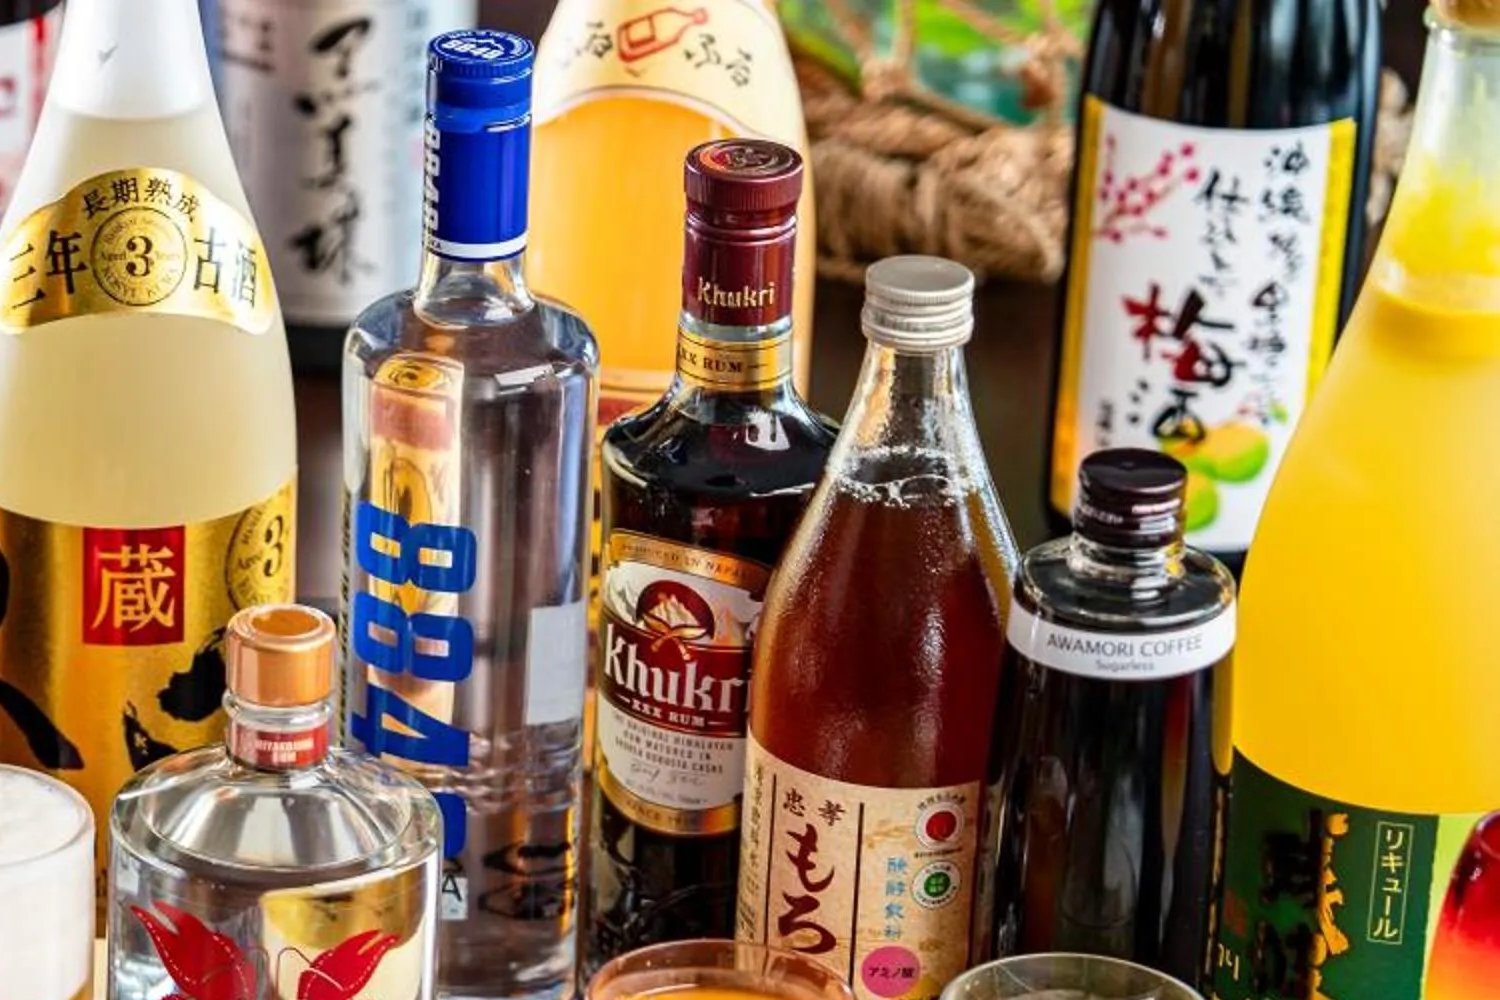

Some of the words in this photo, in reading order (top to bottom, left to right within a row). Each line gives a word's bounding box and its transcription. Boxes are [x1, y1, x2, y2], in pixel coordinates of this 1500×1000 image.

[81, 174, 202, 224] 長期熟成
[125, 235, 153, 277] 3
[193, 226, 259, 311] 古酒
[696, 276, 776, 309] Khukri
[703, 348, 744, 374] RUM
[91, 543, 177, 633] 蔵
[1046, 632, 1134, 657] AWAMORI
[1140, 634, 1204, 657] COFFEE
[1095, 659, 1155, 673] Sugarless
[668, 711, 705, 727] RUM
[1371, 829, 1406, 939] リキュール
